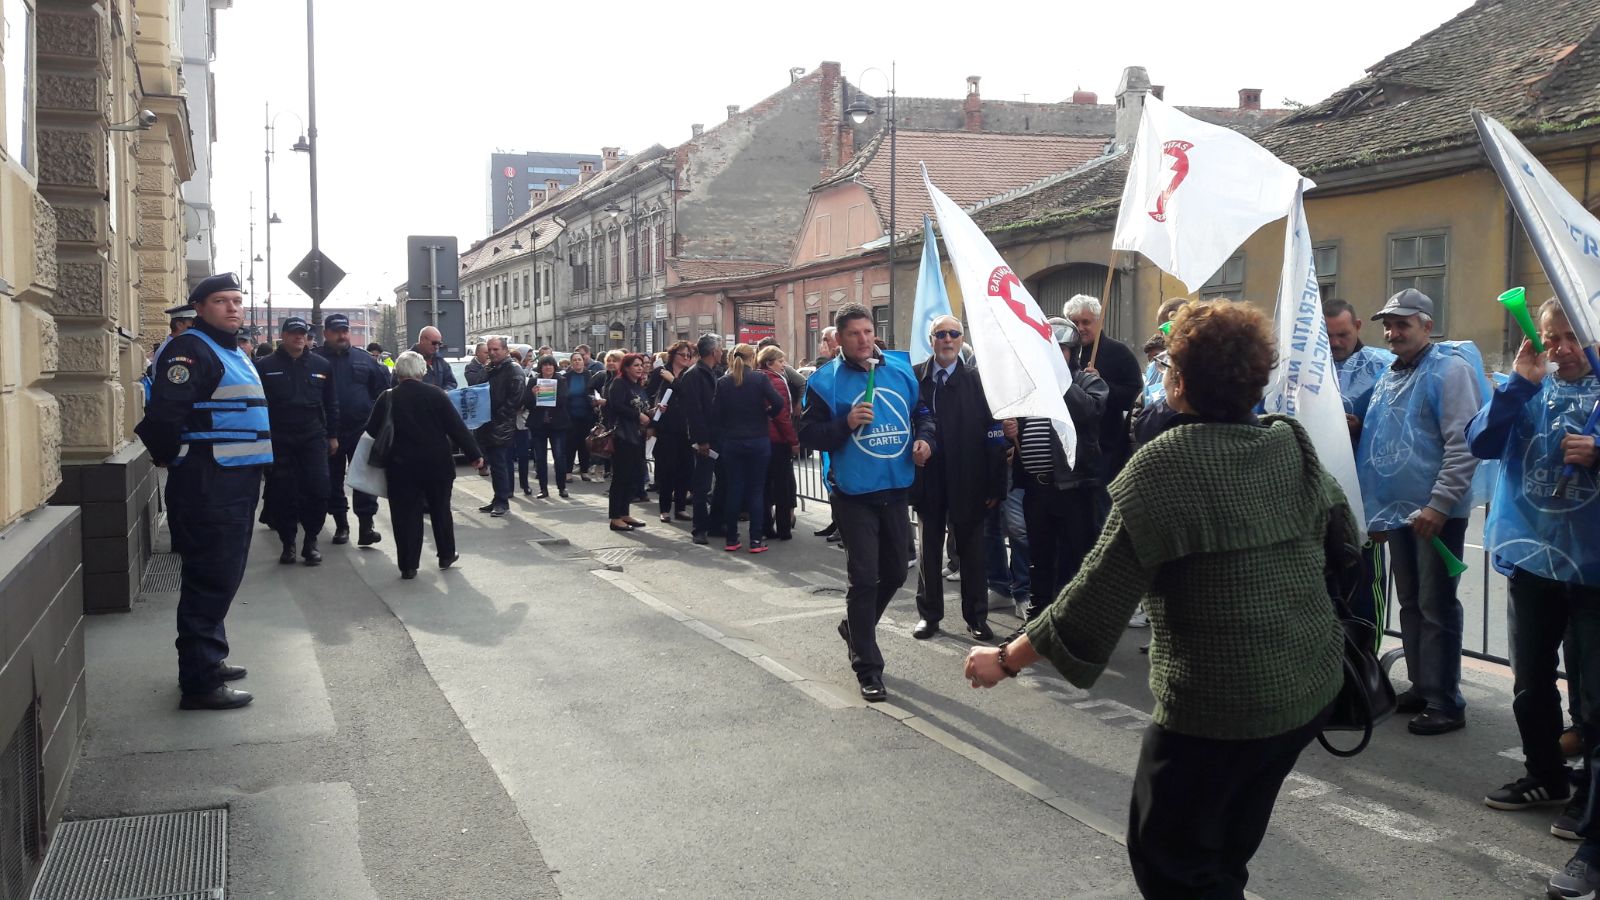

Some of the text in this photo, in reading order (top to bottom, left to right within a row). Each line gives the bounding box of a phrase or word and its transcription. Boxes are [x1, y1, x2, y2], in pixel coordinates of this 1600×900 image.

[506, 180, 515, 223] RAMADA
[871, 422, 898, 434] alfa
[868, 435, 903, 447] CARTEL
[1526, 481, 1585, 502] CAREL
